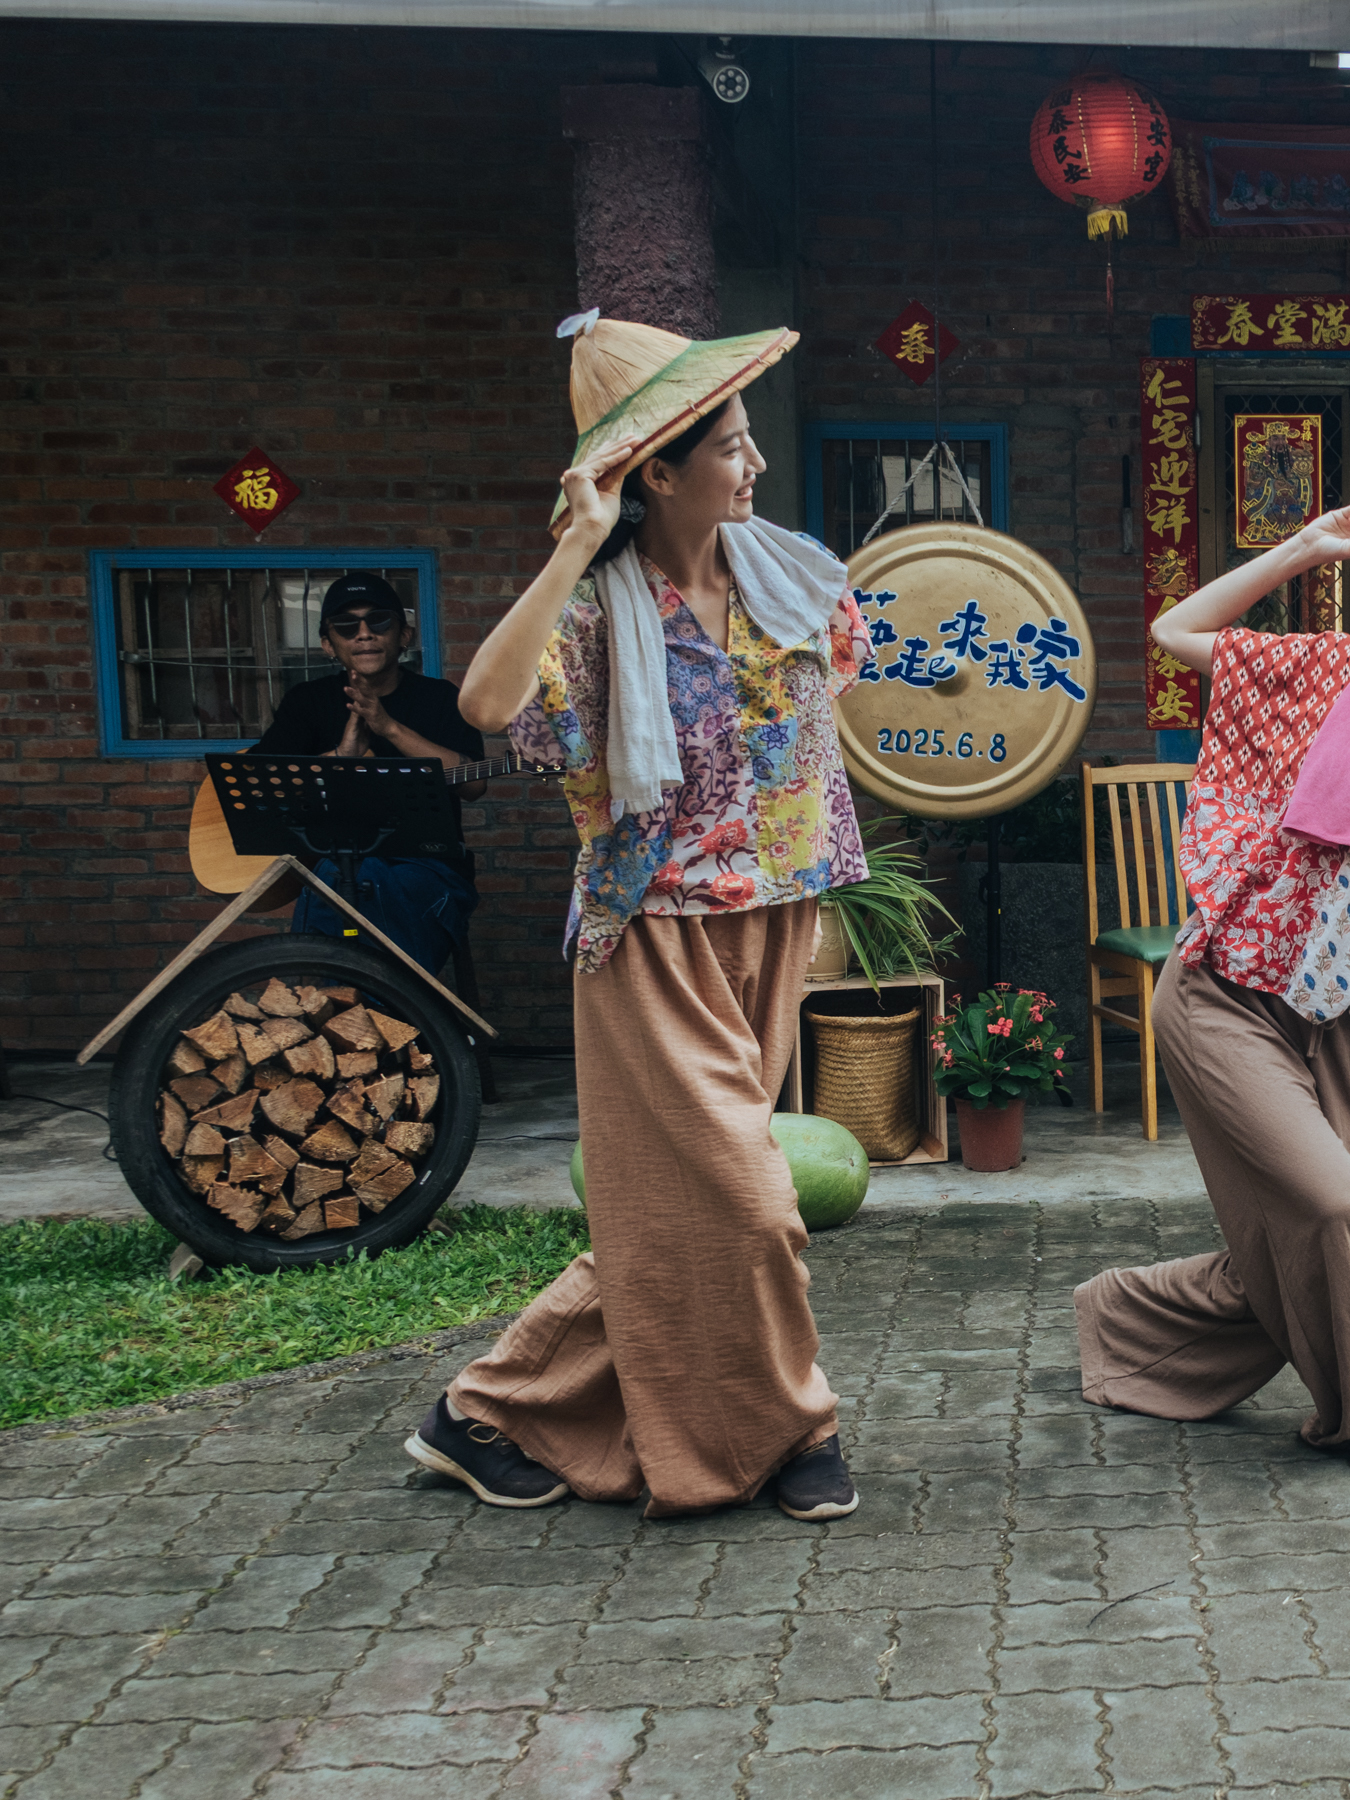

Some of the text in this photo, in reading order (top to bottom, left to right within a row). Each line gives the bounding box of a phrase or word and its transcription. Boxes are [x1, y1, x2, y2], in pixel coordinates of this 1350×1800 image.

[895, 322, 935, 364] 春
[234, 467, 279, 510] 福
[877, 727, 1008, 763] 2025.6.8
